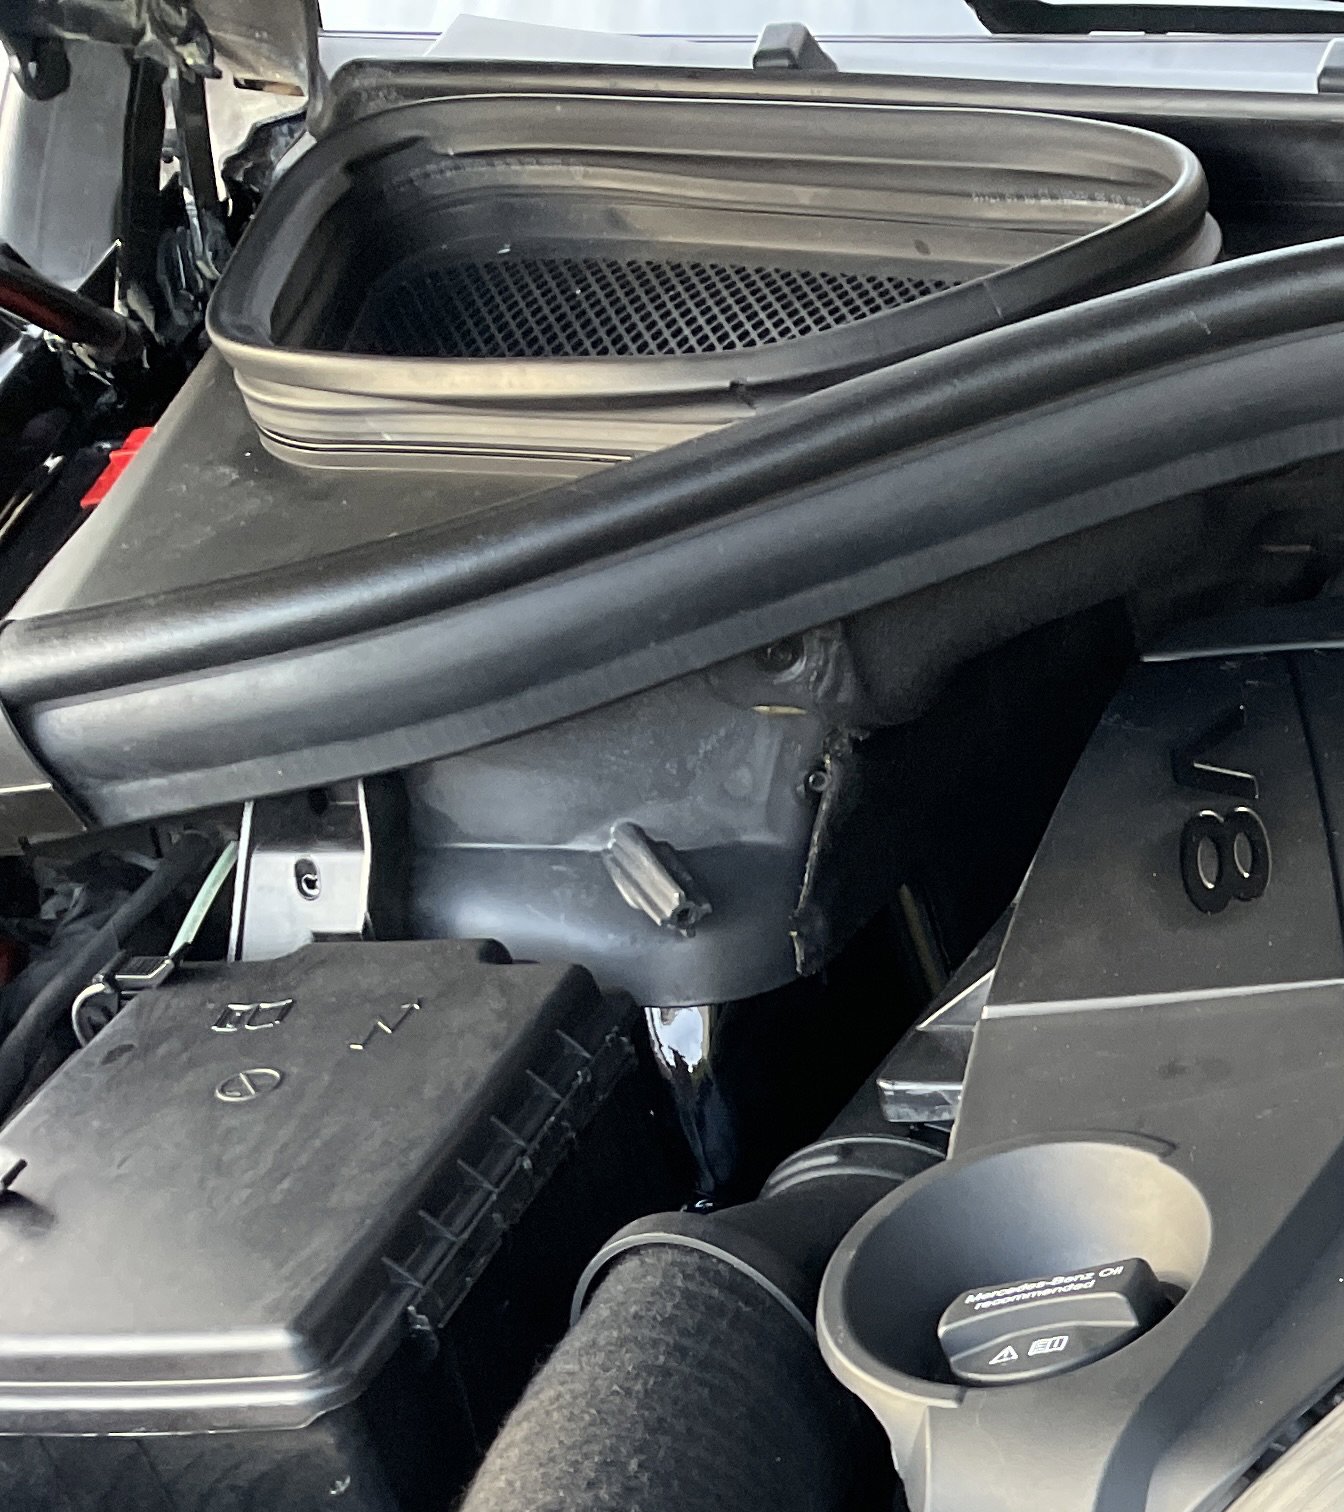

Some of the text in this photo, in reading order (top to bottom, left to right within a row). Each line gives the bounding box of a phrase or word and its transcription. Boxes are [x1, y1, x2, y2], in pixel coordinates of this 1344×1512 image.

[1169, 704, 1273, 914] V8
[965, 1265, 1124, 1304] Mercedes-Benz Oil
[974, 1280, 1095, 1309] recommended
